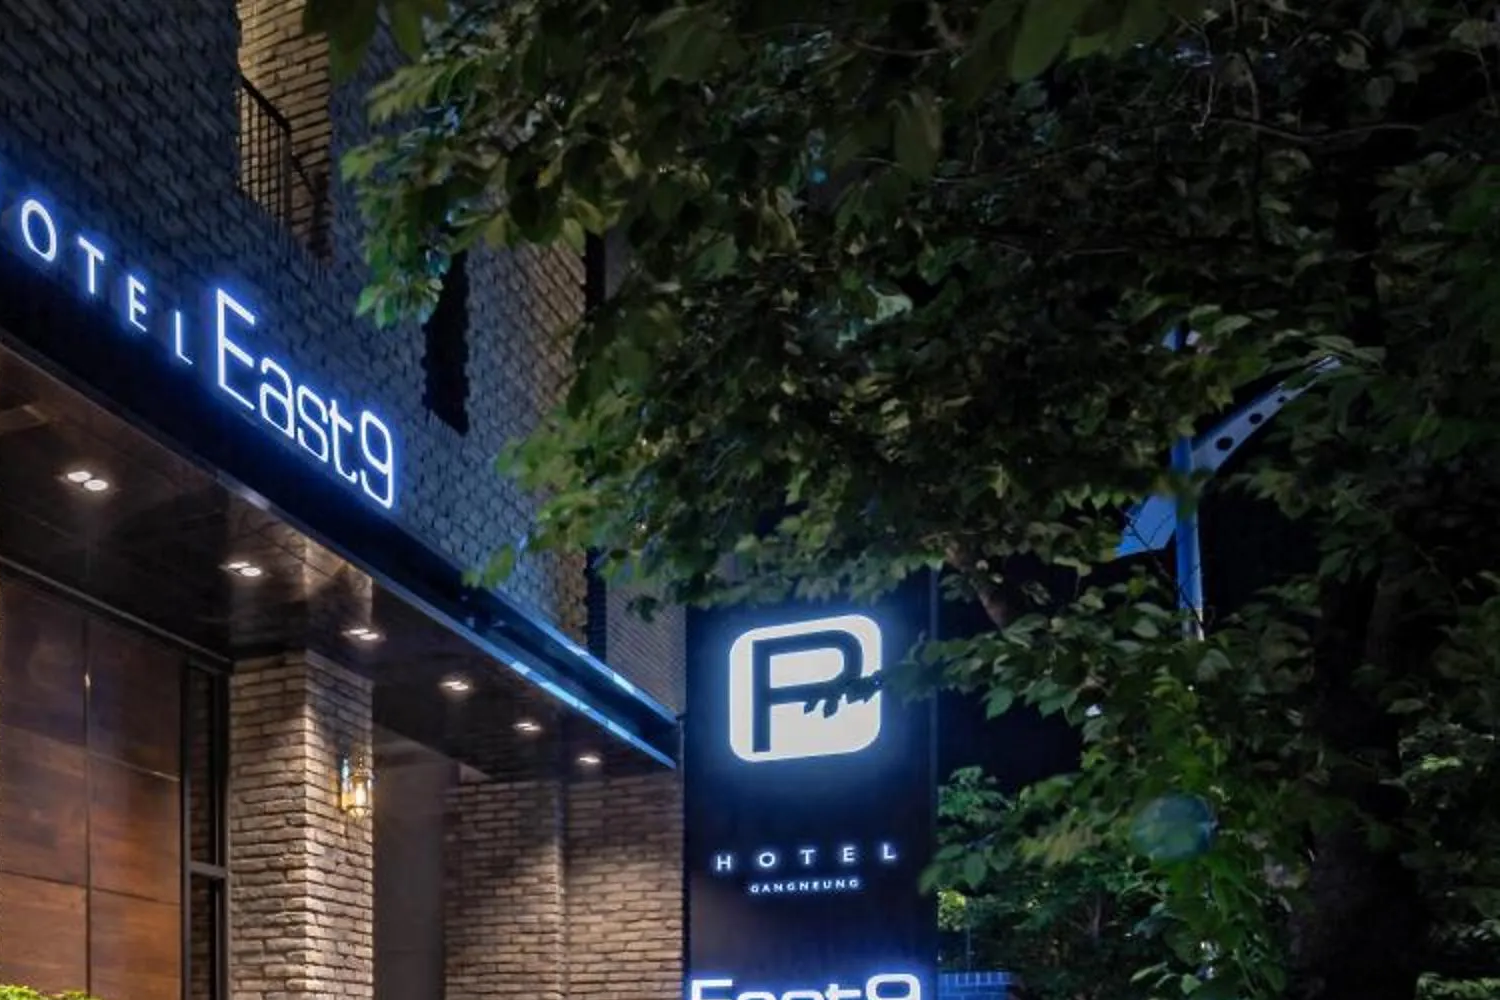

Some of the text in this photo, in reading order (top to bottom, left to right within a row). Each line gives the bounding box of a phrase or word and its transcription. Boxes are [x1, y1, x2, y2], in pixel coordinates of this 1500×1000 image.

[216, 287, 394, 509] East9
[716, 842, 897, 871] HOTEL
[749, 879, 860, 893] GANGNEUNG
